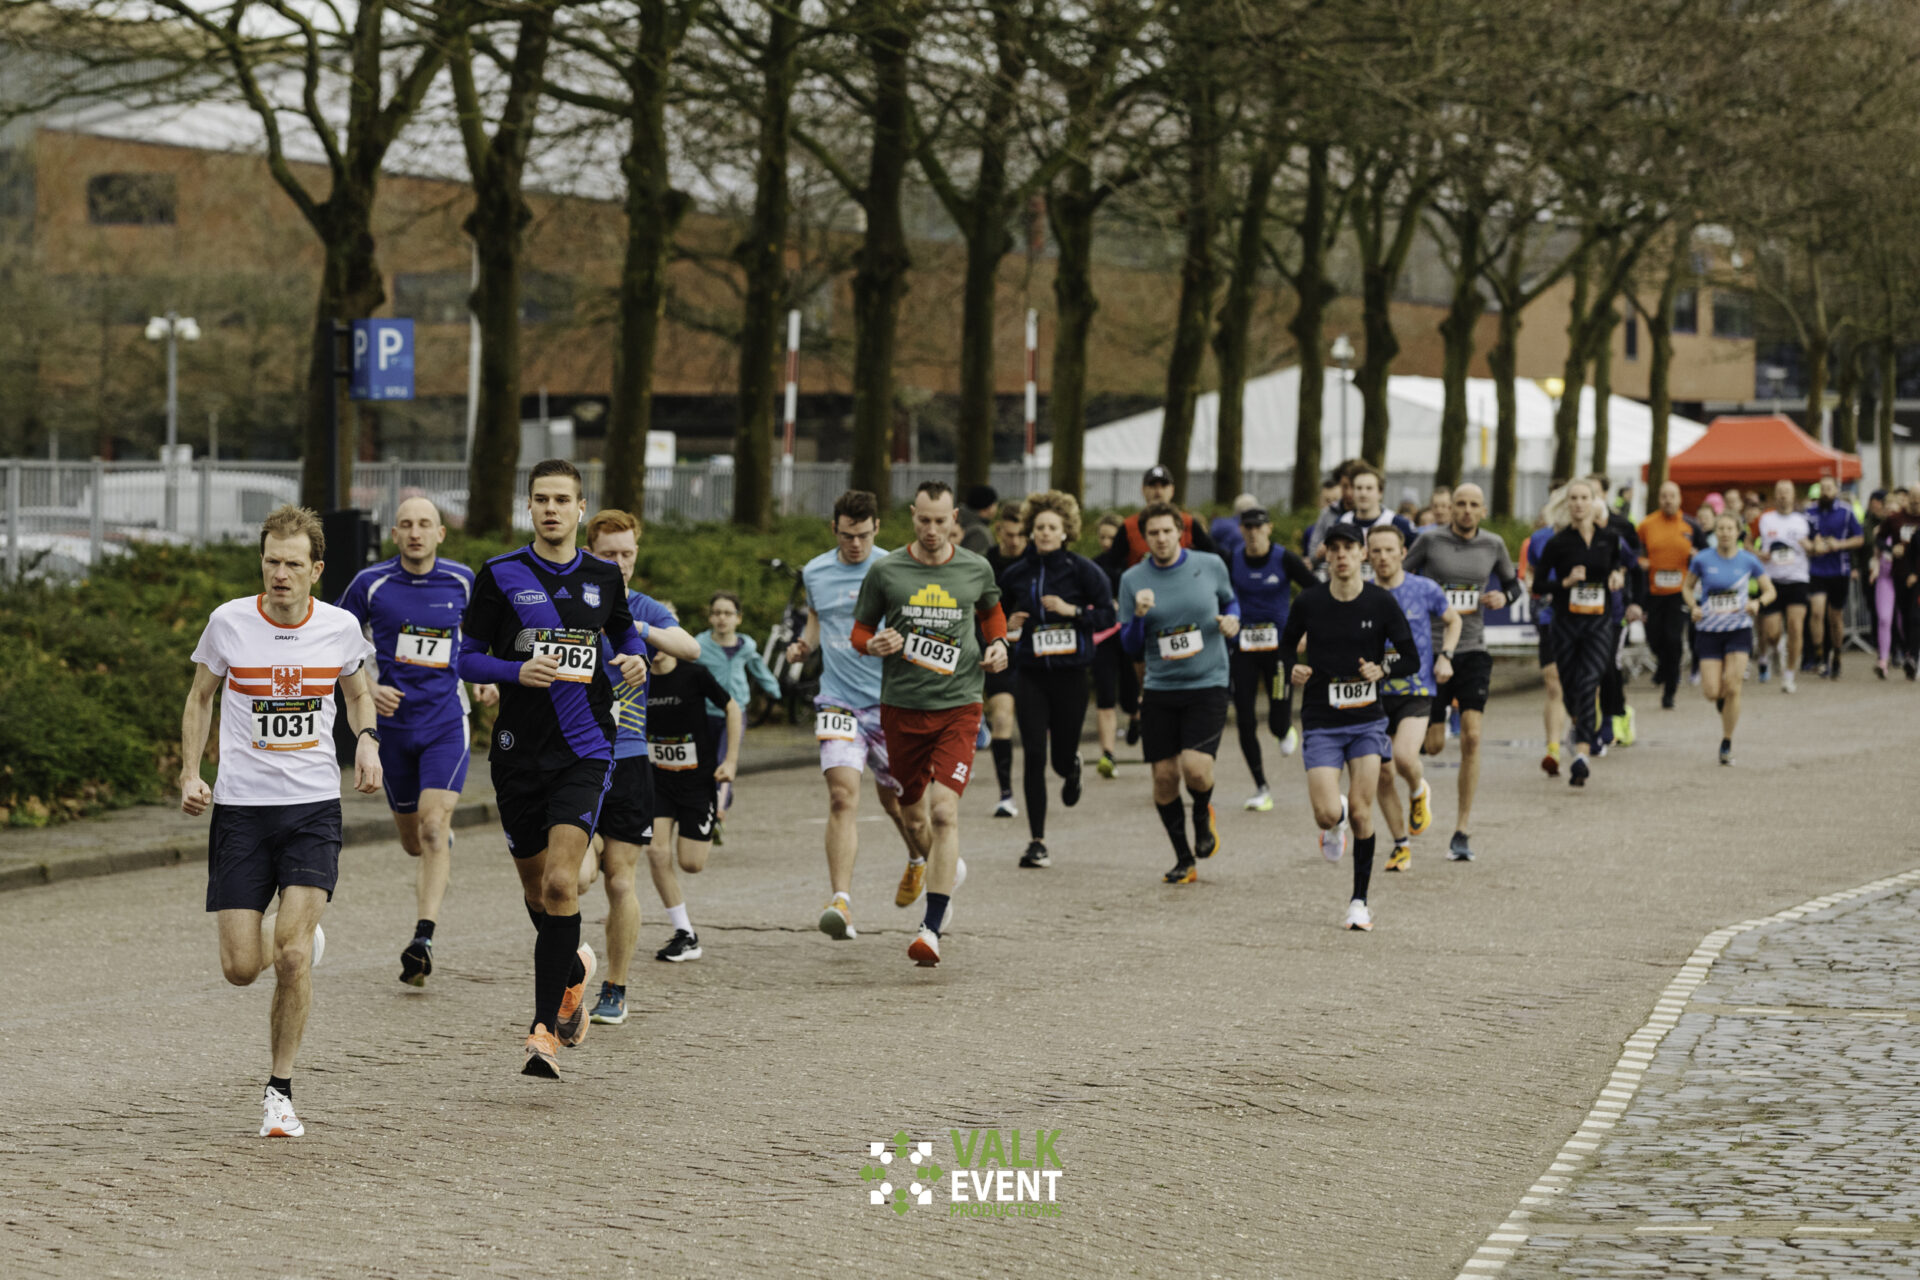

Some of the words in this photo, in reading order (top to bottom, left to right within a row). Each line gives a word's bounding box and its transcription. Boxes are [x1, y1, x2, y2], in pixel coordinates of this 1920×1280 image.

[379, 328, 403, 371] P
[902, 606, 922, 617] MUD
[923, 607, 962, 620] MASTERS
[415, 638, 438, 656] 17
[1037, 630, 1072, 648] 1033
[1170, 635, 1189, 651] 68
[911, 637, 955, 664] 1093
[1334, 683, 1372, 699] 1087
[257, 713, 314, 738] 1031
[821, 714, 853, 731] 105
[654, 745, 686, 761] 506
